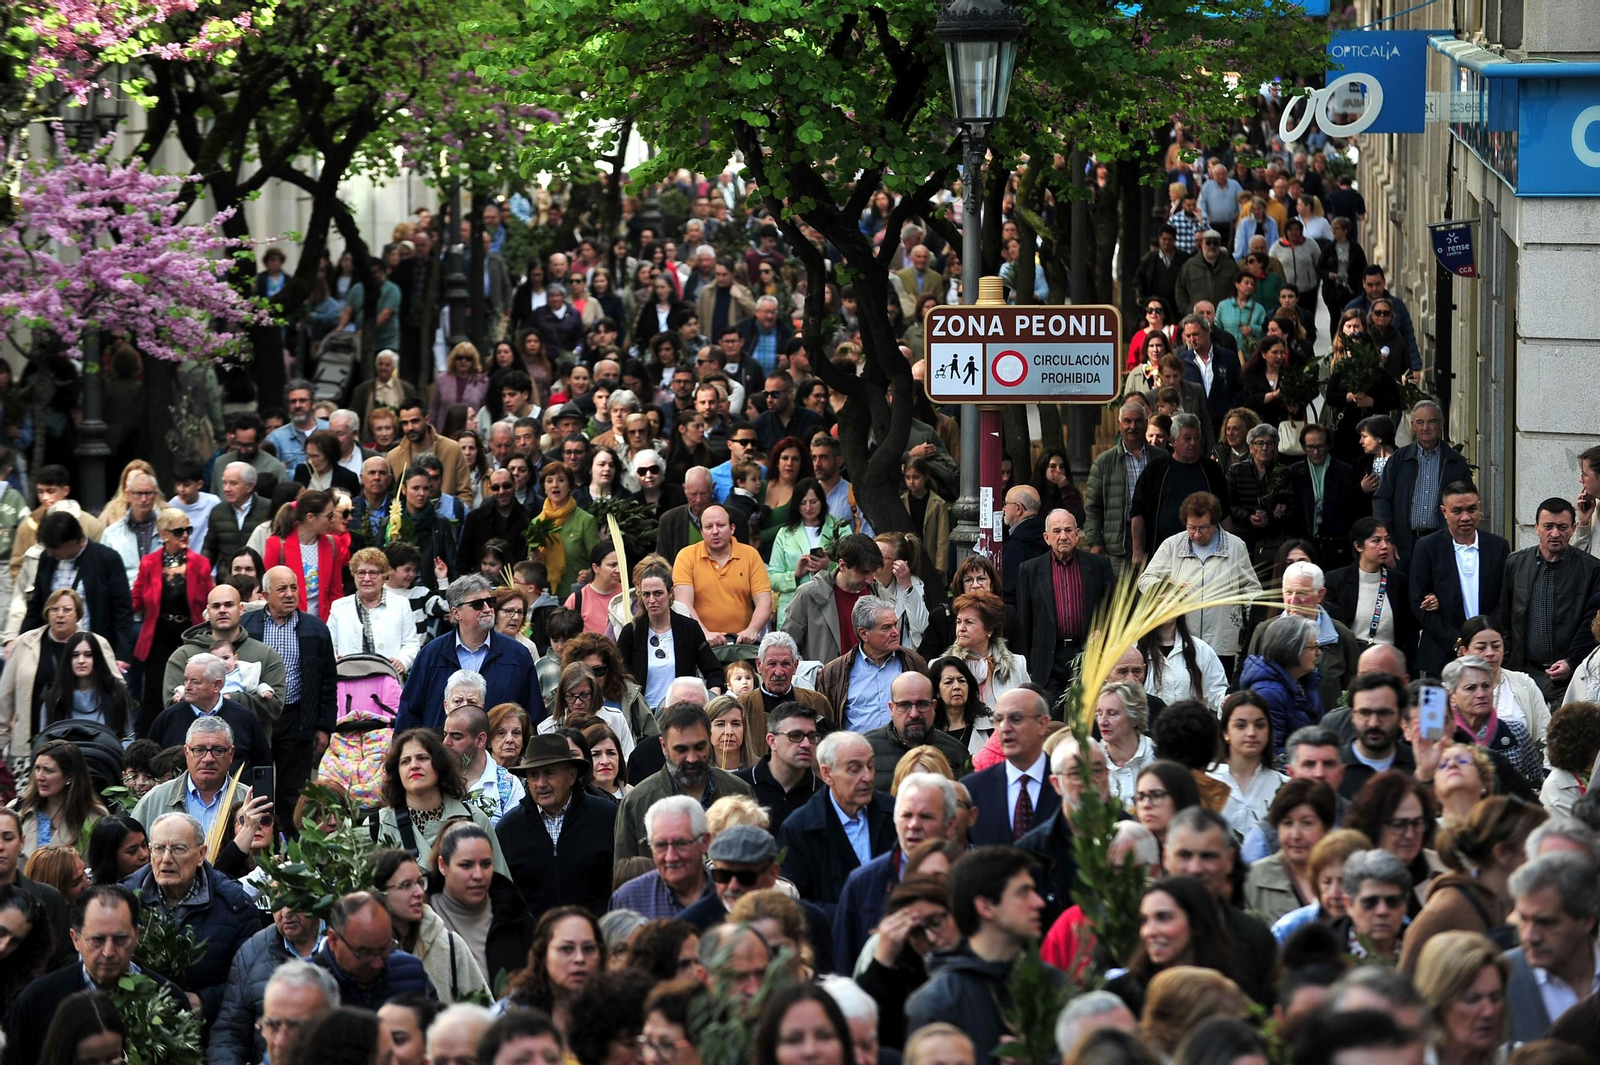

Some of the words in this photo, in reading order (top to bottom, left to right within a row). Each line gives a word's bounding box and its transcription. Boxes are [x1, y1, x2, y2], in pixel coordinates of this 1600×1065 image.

[1458, 266, 1472, 274] cca
[932, 315, 1004, 337] ZONA
[1015, 315, 1113, 337] PEONIL
[1033, 352, 1110, 366] CIRCULACIÓN
[1041, 372, 1101, 384] PROHIBIDA
